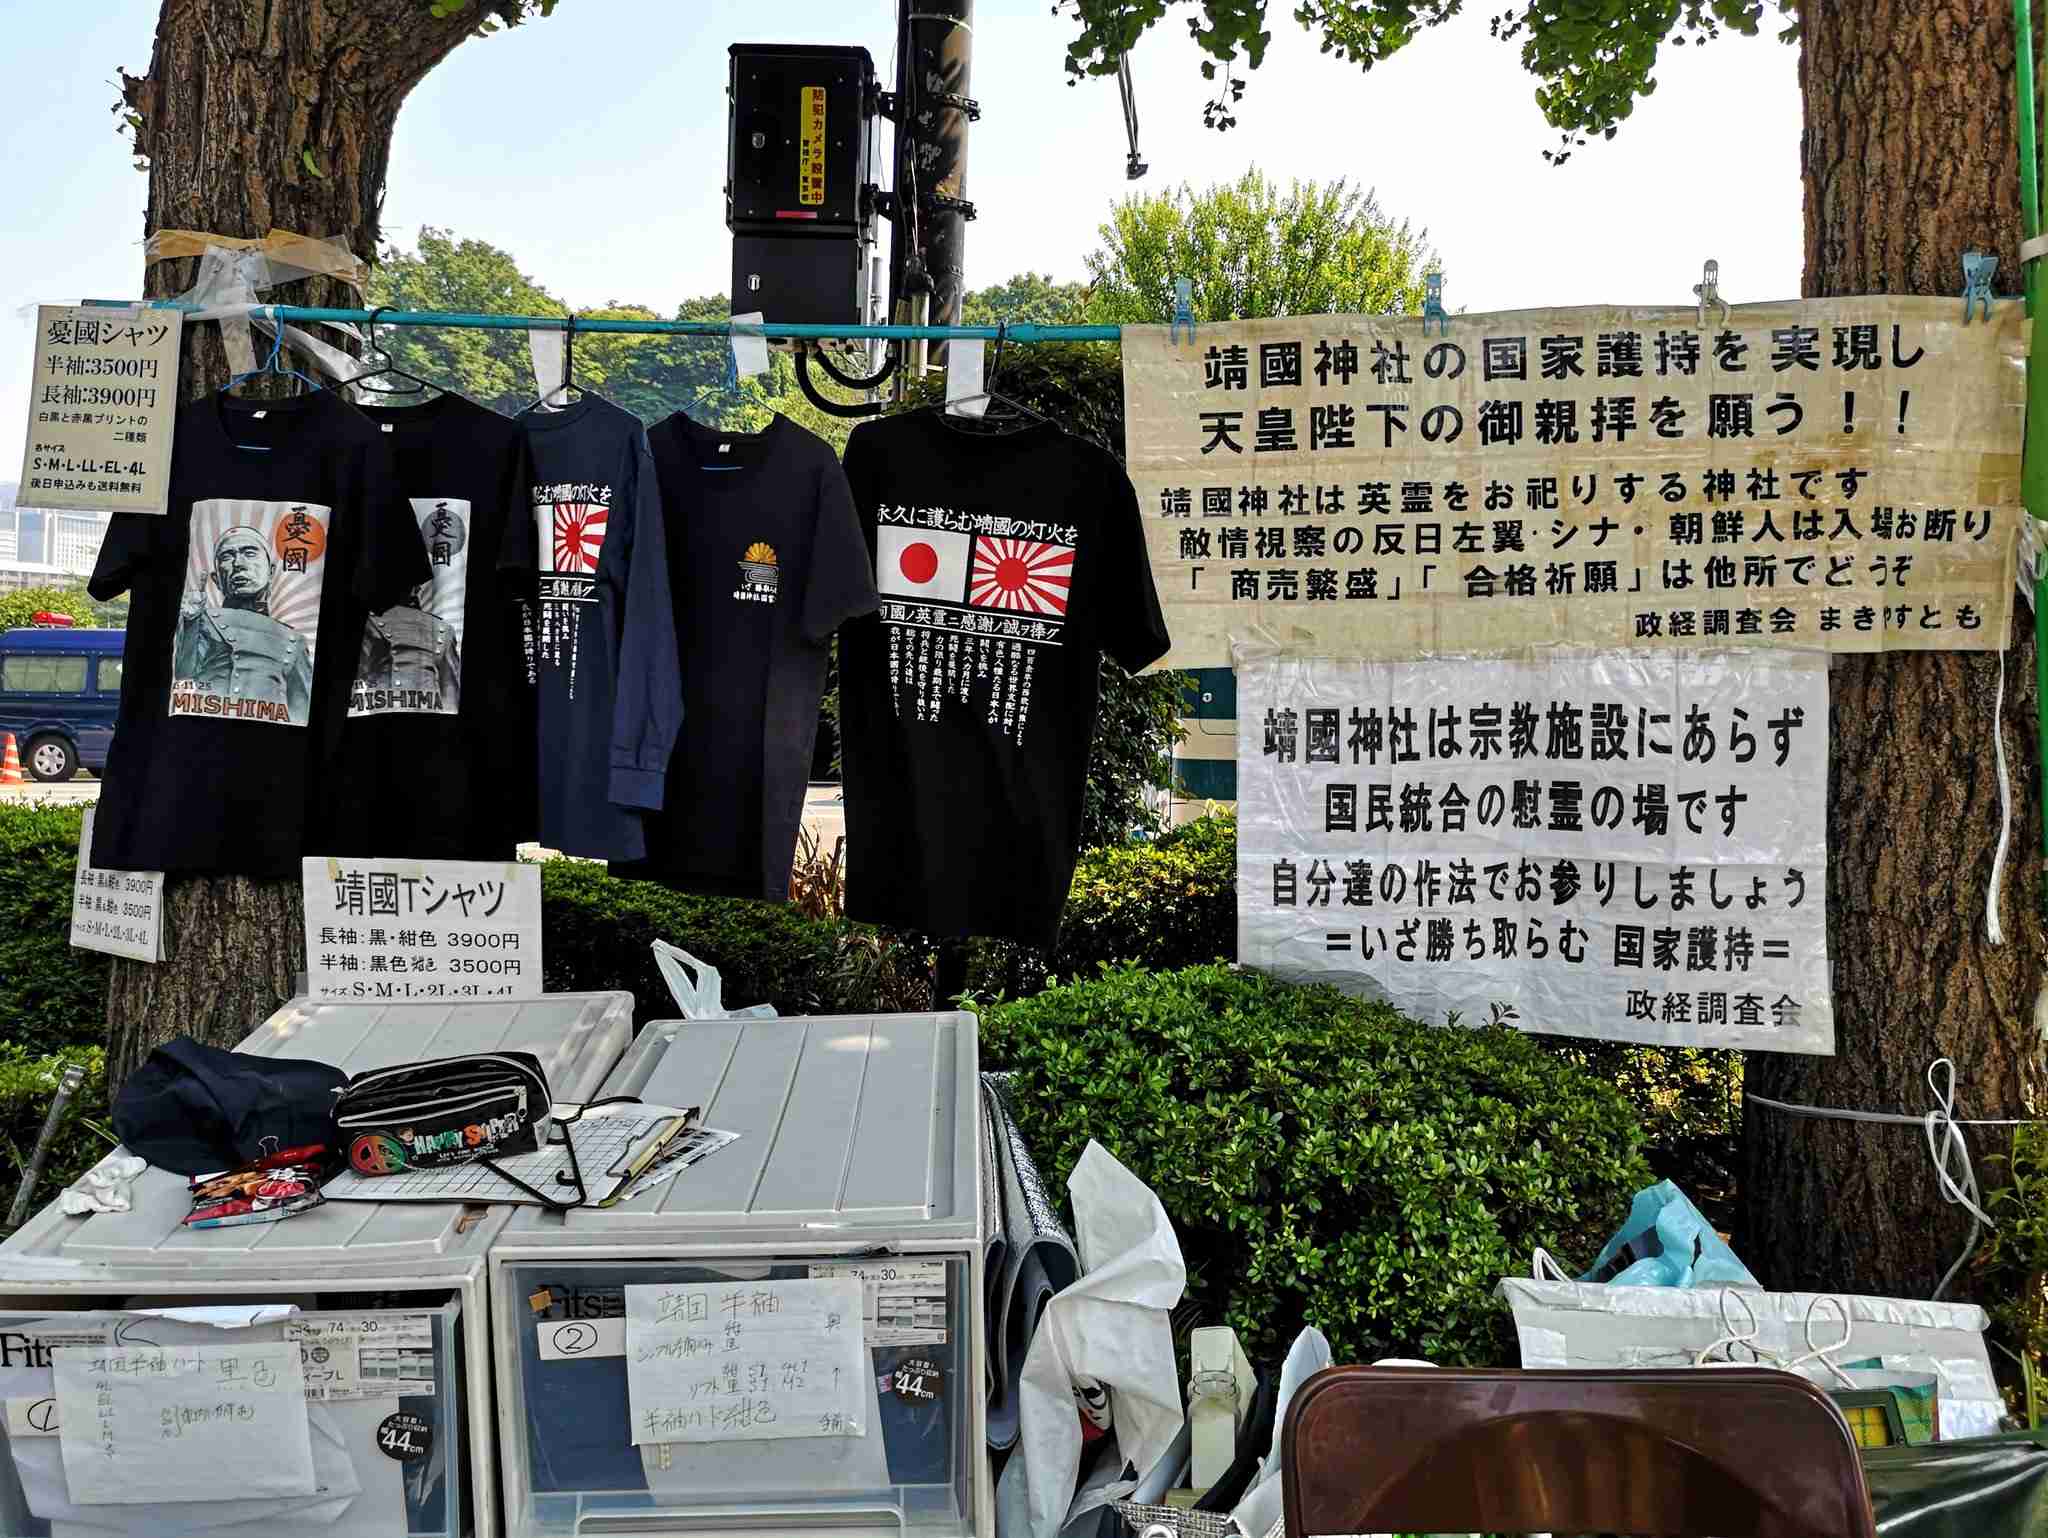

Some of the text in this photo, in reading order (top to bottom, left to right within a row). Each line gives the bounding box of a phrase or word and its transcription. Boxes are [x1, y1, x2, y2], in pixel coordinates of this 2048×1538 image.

[1203, 324, 1926, 391] 靖國神社の国家護持を実現し
[38, 411, 148, 427] 白黒と赤黒プリントの
[112, 431, 147, 444] 二種類
[30, 477, 142, 494] 後日申込みも送料無料
[1160, 467, 1869, 518] 靖國神社は英霊をお祀りする神社です
[877, 503, 1080, 546] 永久に護らむ靖國の灯火を
[1634, 607, 1797, 638] 政経調査会
[173, 692, 290, 722] MISHIMA
[1263, 701, 1804, 767] 靖國神社は宗教施設にあらず
[1324, 779, 1749, 837] 国民統合の慰霊の場です
[335, 870, 505, 918] 靖國Tシャツ
[1271, 857, 1807, 911] 自分達の作法でお参りしましょう
[447, 932, 520, 950] 3900円
[449, 958, 521, 976] 3500円
[1624, 989, 1803, 1028] 政経調査会
[881, 1268, 896, 1281] 30
[328, 1320, 378, 1333] 74 30
